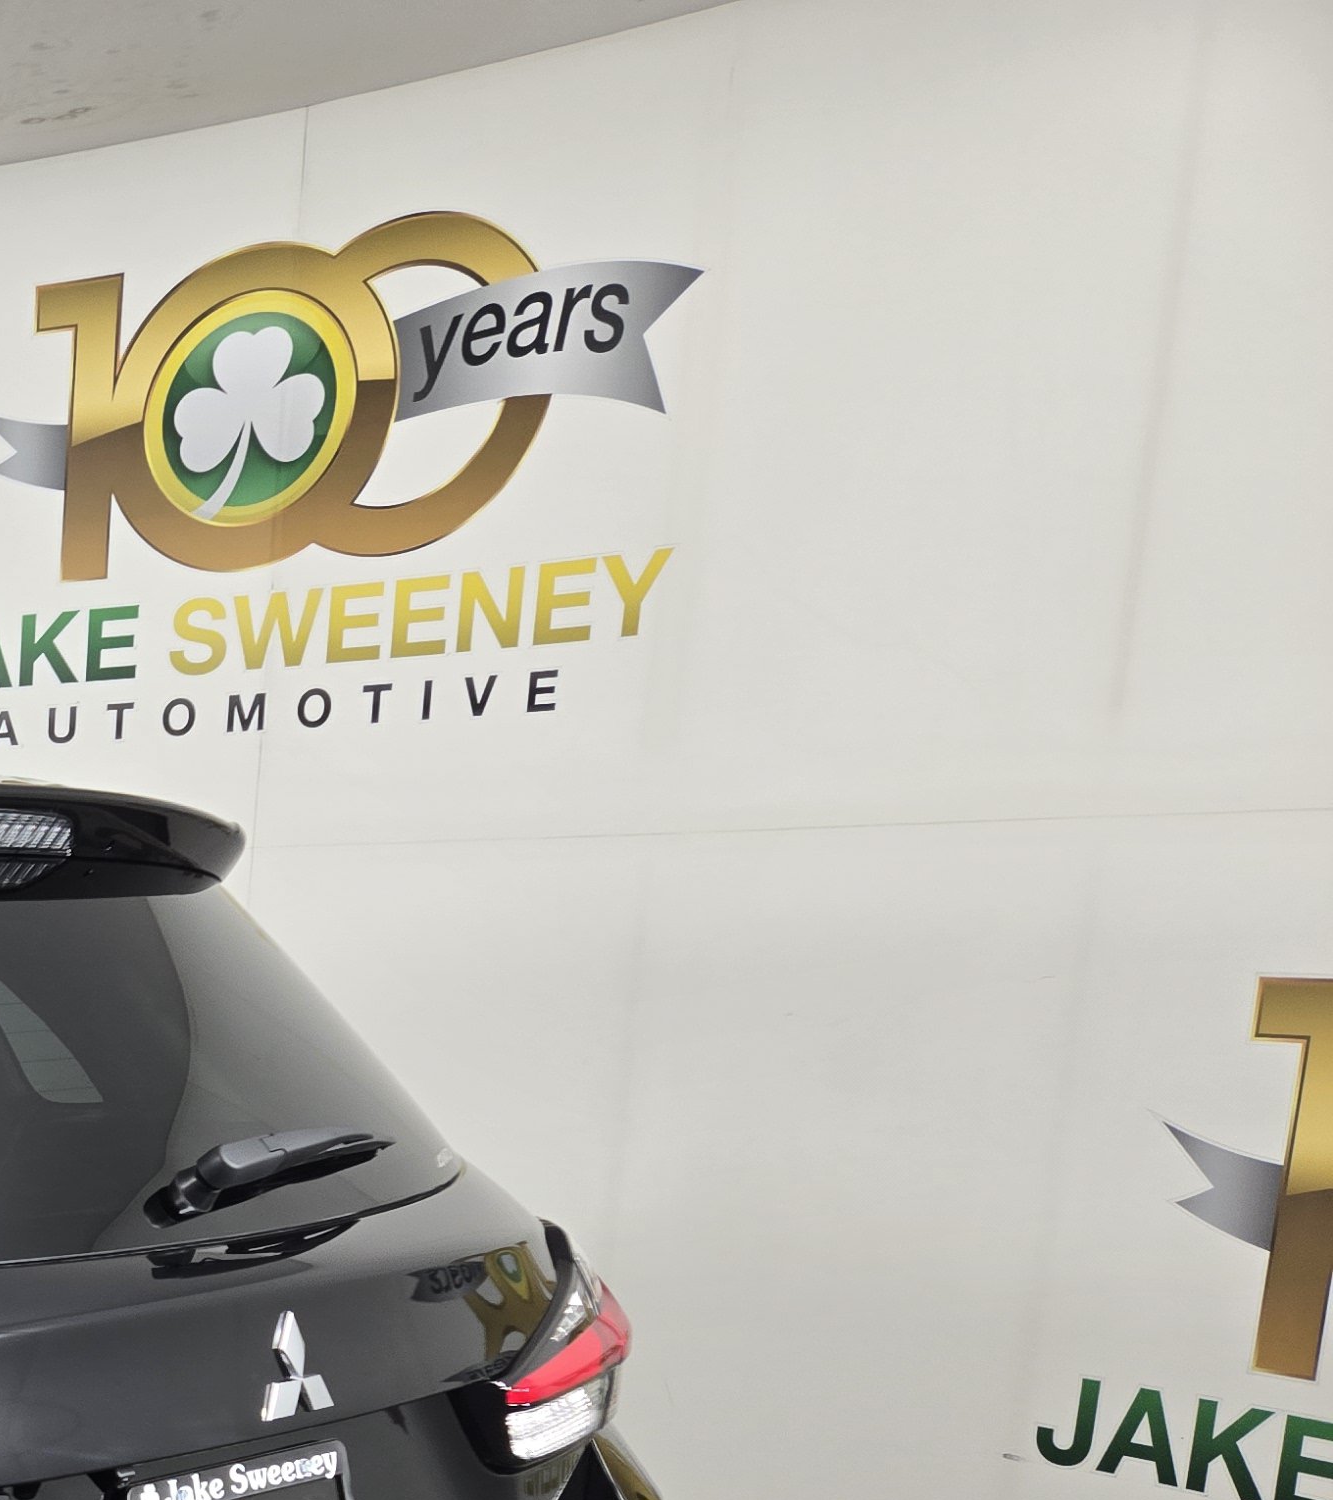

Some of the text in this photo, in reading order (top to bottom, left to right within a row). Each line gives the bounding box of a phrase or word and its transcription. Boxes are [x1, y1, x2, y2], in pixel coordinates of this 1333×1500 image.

[35, 210, 552, 583] 100
[414, 283, 629, 401] years
[169, 547, 674, 675] SWEENEY
[229, 1451, 338, 1494] Sweeney
